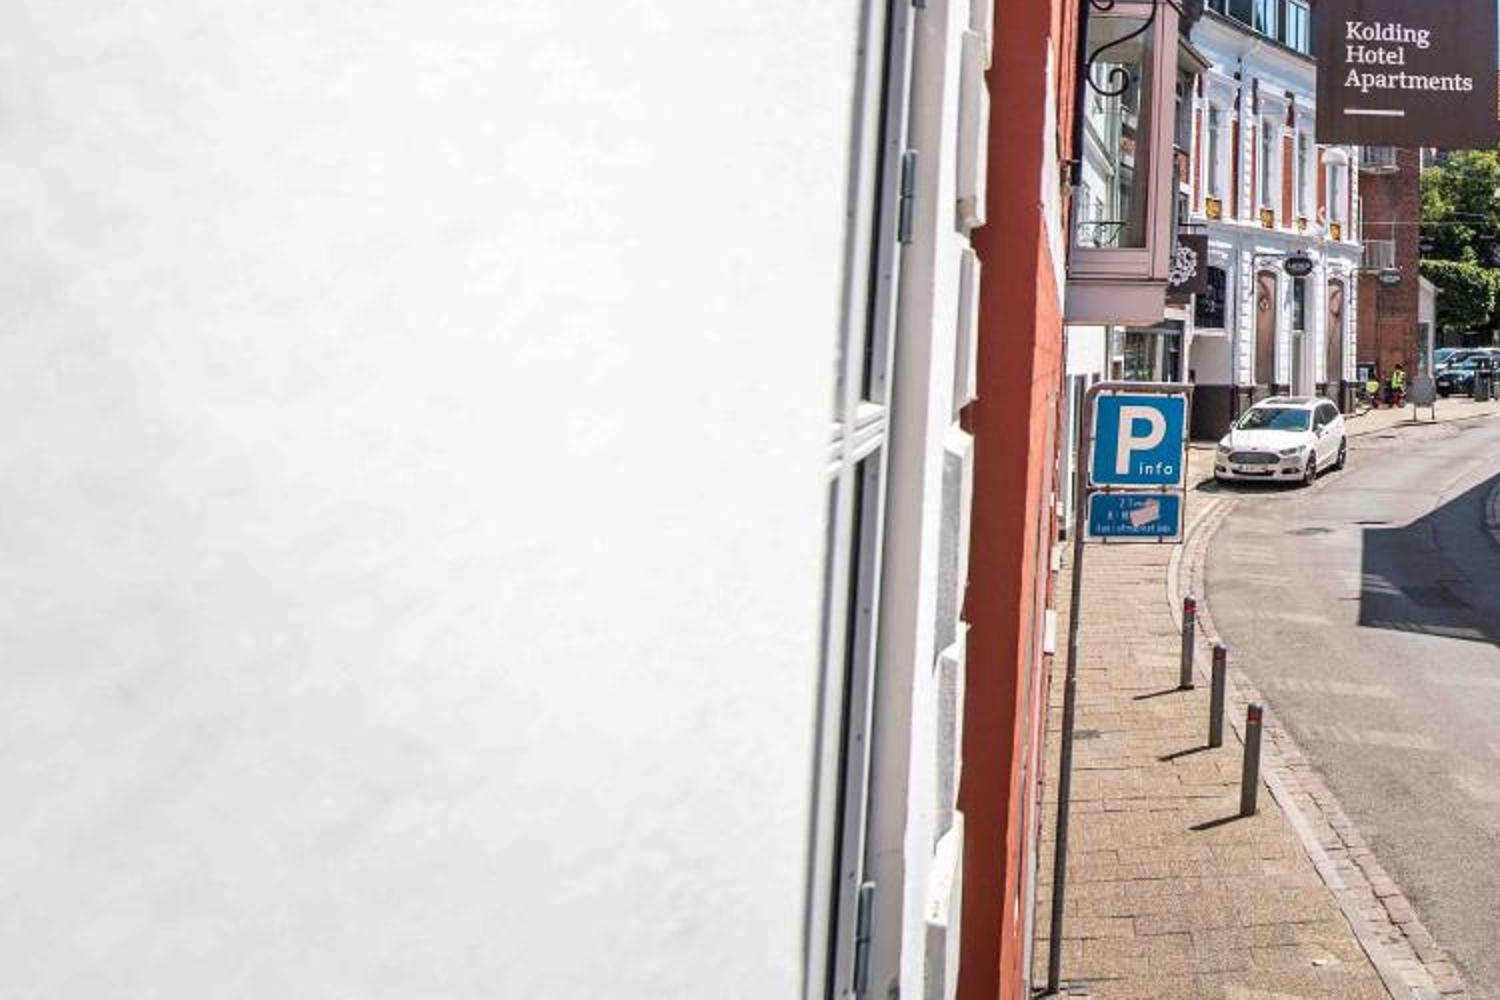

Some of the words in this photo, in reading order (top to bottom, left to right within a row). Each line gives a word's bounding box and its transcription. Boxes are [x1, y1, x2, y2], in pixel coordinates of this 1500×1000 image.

[1345, 21, 1430, 49] Kolding
[1345, 45, 1404, 65] Hotel
[1344, 68, 1473, 93] Apartments
[1116, 405, 1166, 475] P
[1139, 462, 1173, 475] info
